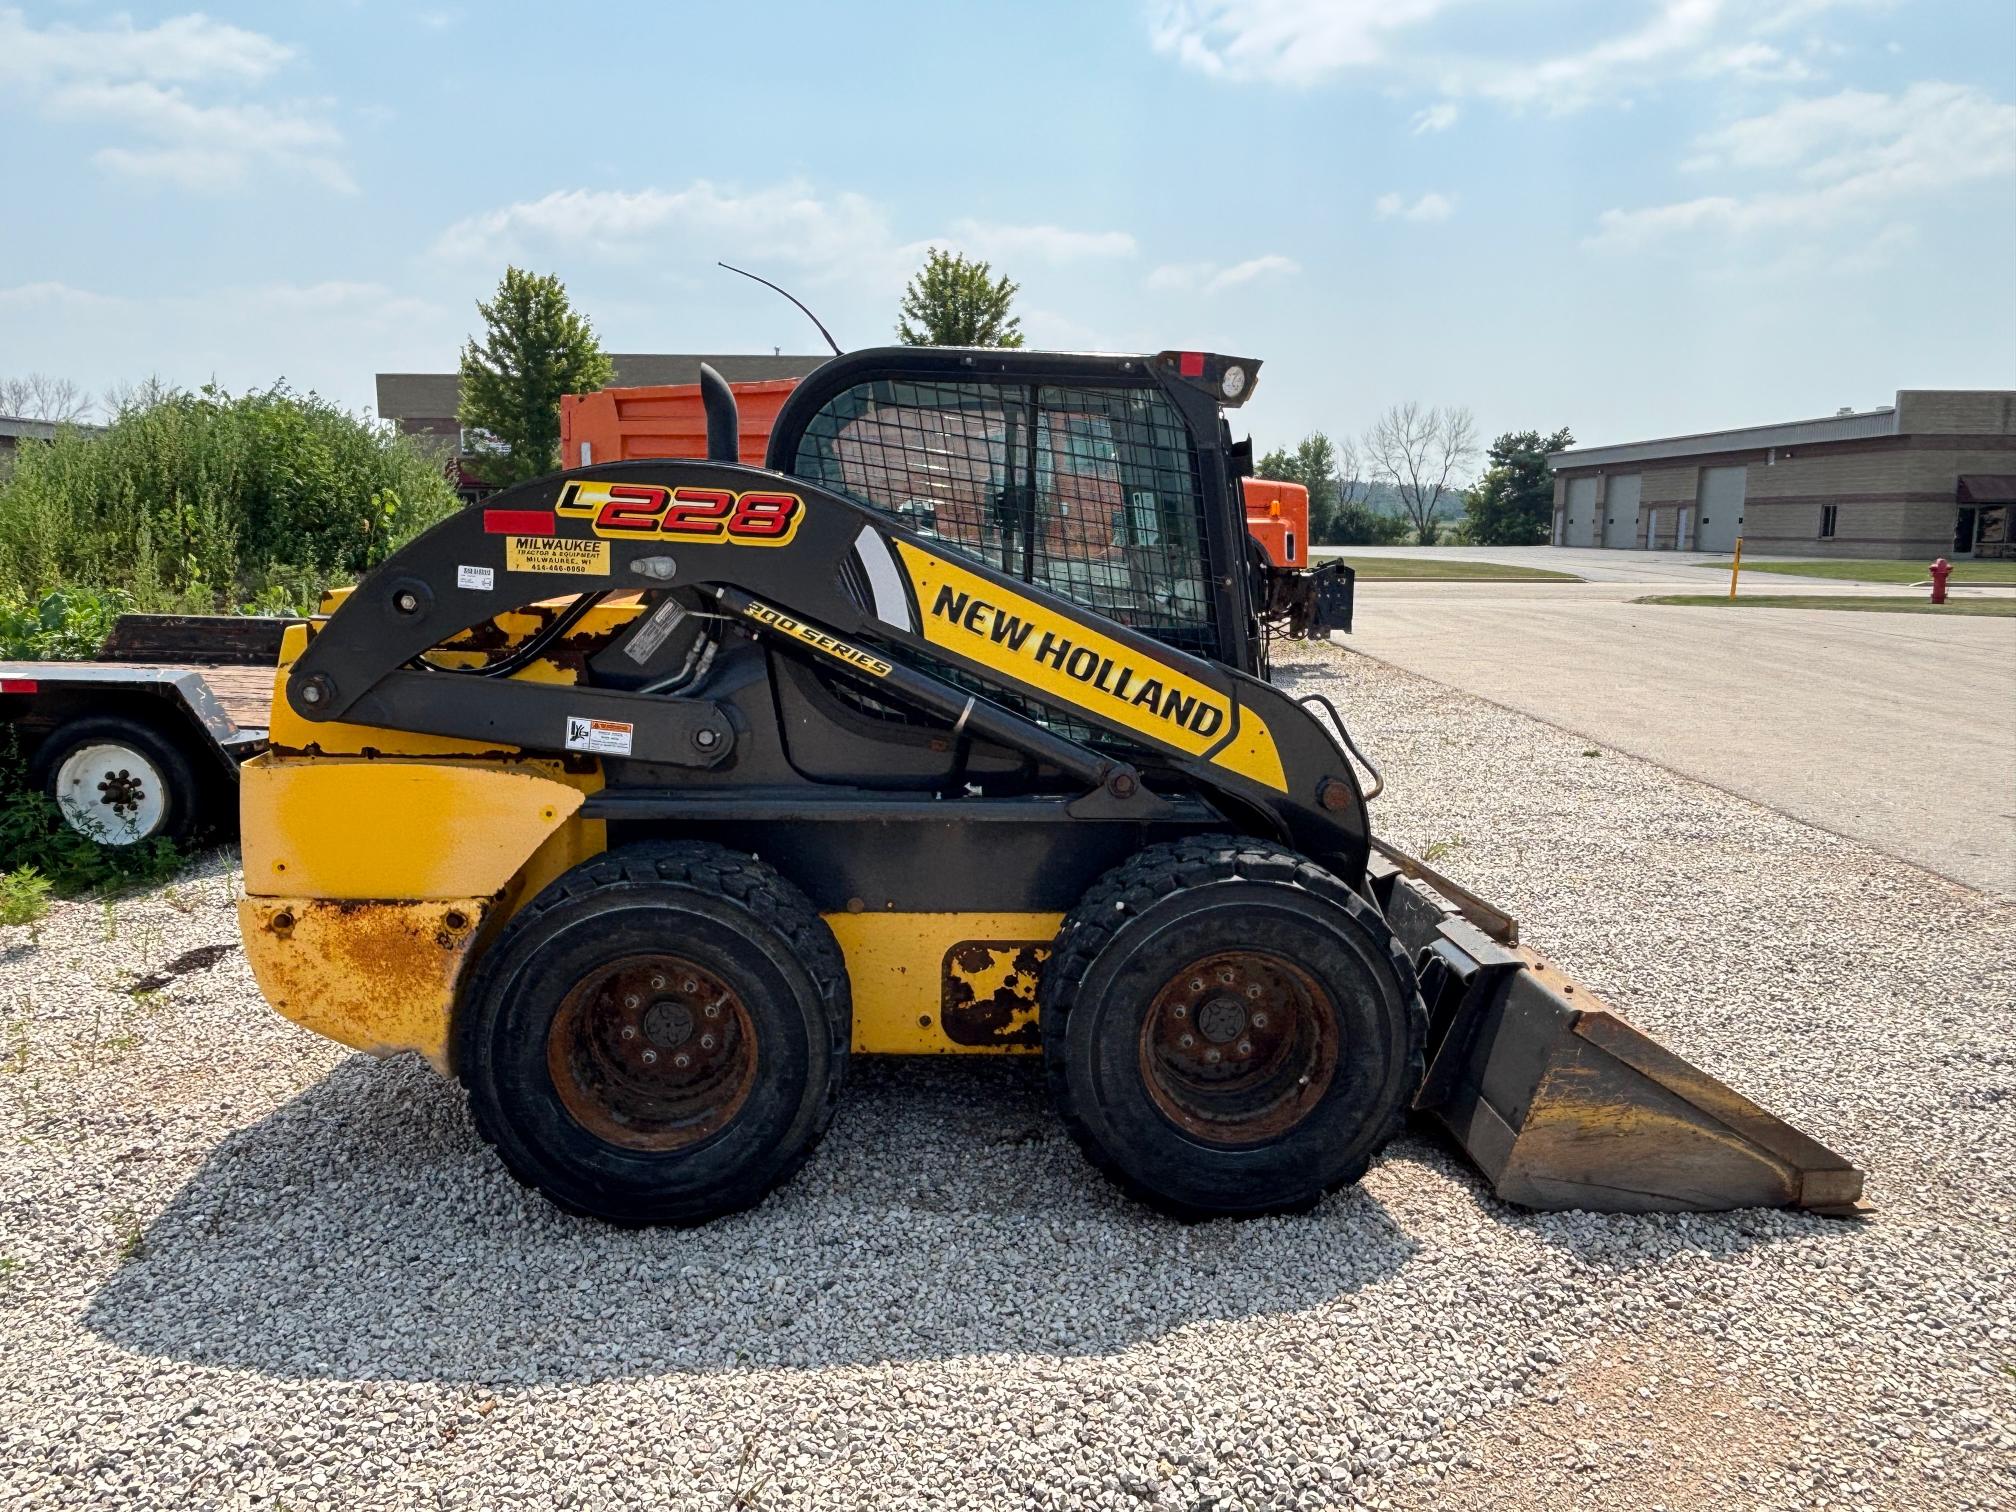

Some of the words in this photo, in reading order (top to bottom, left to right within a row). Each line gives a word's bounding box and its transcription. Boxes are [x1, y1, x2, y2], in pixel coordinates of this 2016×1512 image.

[558, 484, 800, 540] L228
[516, 538, 601, 552] MILWAUKEE
[799, 627, 891, 674] SERIES
[931, 584, 1035, 652] NEW
[1034, 631, 1224, 738] HOLLAND
